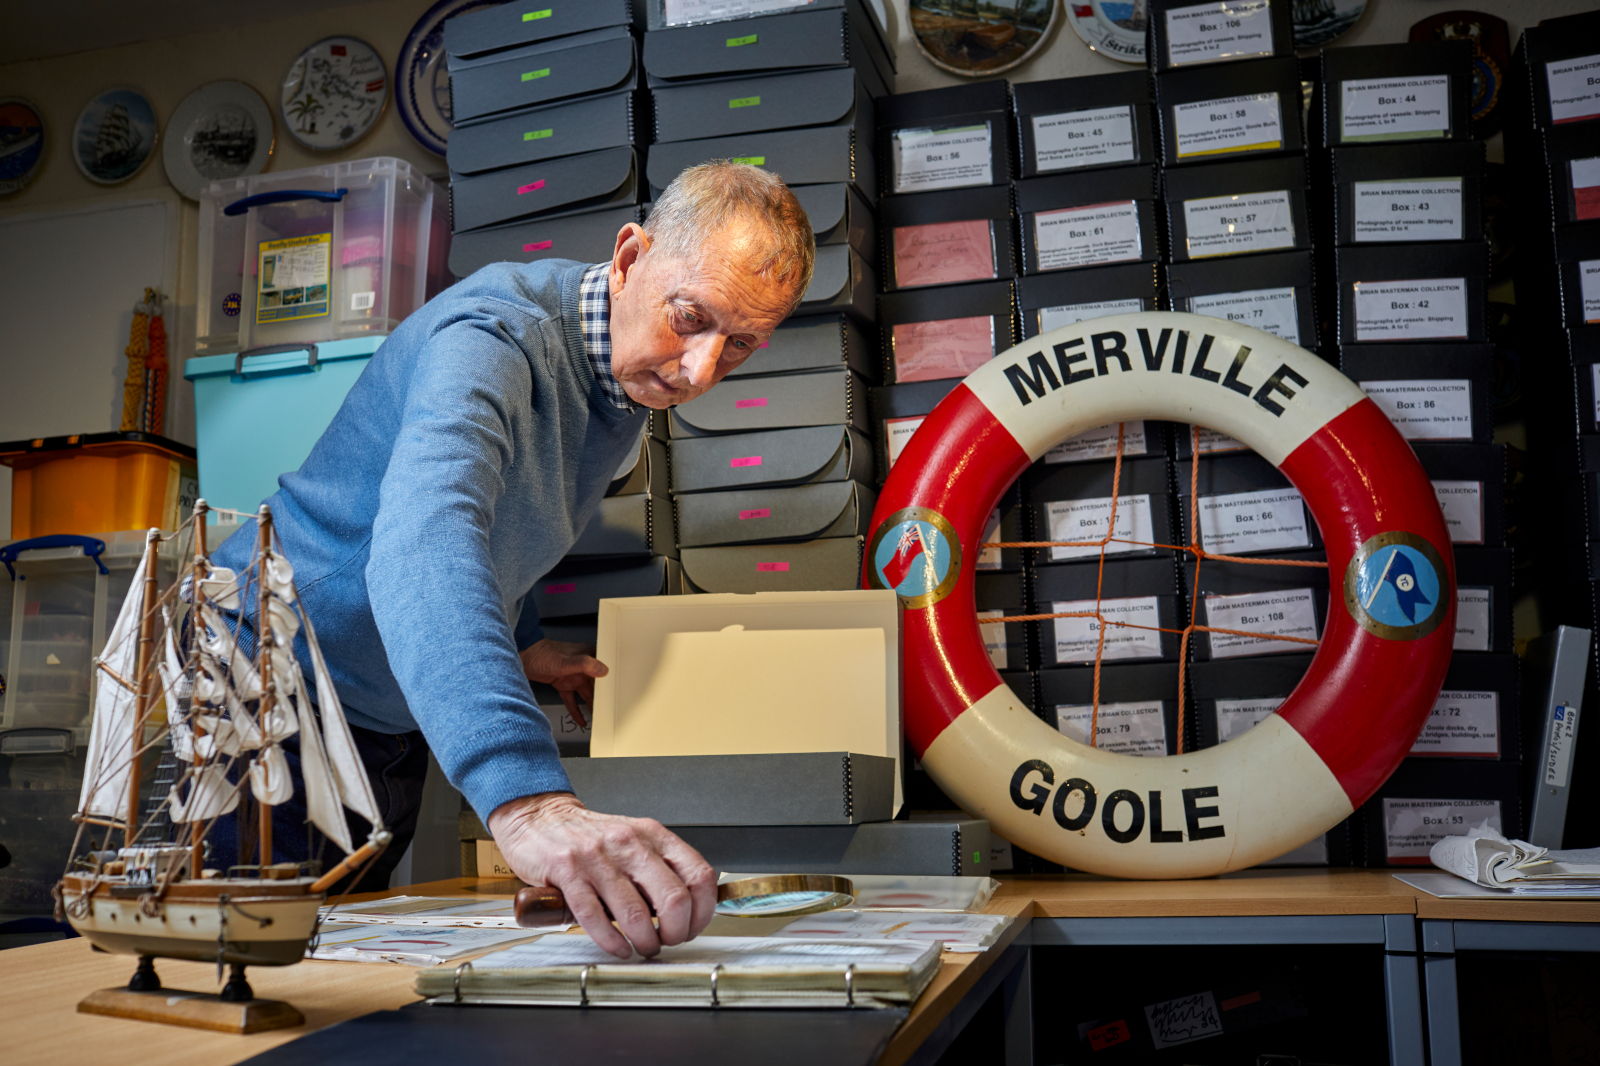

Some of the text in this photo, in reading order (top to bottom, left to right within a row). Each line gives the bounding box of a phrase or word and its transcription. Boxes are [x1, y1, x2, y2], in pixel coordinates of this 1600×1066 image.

[1200, 20, 1241, 32] Box 106
[1553, 67, 1572, 75] BRIAN
[1368, 82, 1406, 90] MASTERMAN
[1408, 79, 1446, 87] COLLECTION
[1210, 110, 1246, 122] Box 58
[1068, 129, 1103, 140] Box 45
[927, 152, 960, 162] Box 56
[1209, 202, 1246, 211] MASTERMAN
[1248, 198, 1285, 207] COLLECTION
[1391, 203, 1409, 211] Box
[1059, 215, 1094, 224] MASTERMAN
[1096, 210, 1131, 220] COLLECTION
[1221, 214, 1256, 225] Box 57
[1069, 227, 1104, 238] Box 61
[1421, 285, 1460, 293] COLLECTION
[1391, 302, 1409, 310] Box
[1227, 313, 1244, 321] Box
[1003, 327, 1309, 418] MERVILLE
[1397, 401, 1415, 409] Box
[1109, 499, 1145, 508] CLLECTION
[1224, 499, 1261, 508] MASTERMAN
[1263, 494, 1300, 504] COLLECTION
[1262, 512, 1273, 520] 66
[1080, 519, 1097, 527] Box
[1232, 599, 1269, 609] MASTERMAN
[1271, 595, 1309, 605] COLLECTION
[1117, 605, 1153, 613] COLLECTION
[1241, 612, 1284, 624] Box 108
[1121, 709, 1158, 717] COLLECTION
[1449, 708, 1460, 716] 72
[1120, 724, 1130, 732] 79
[1010, 759, 1226, 844] GOOLE
[1423, 816, 1463, 824] Box 53
